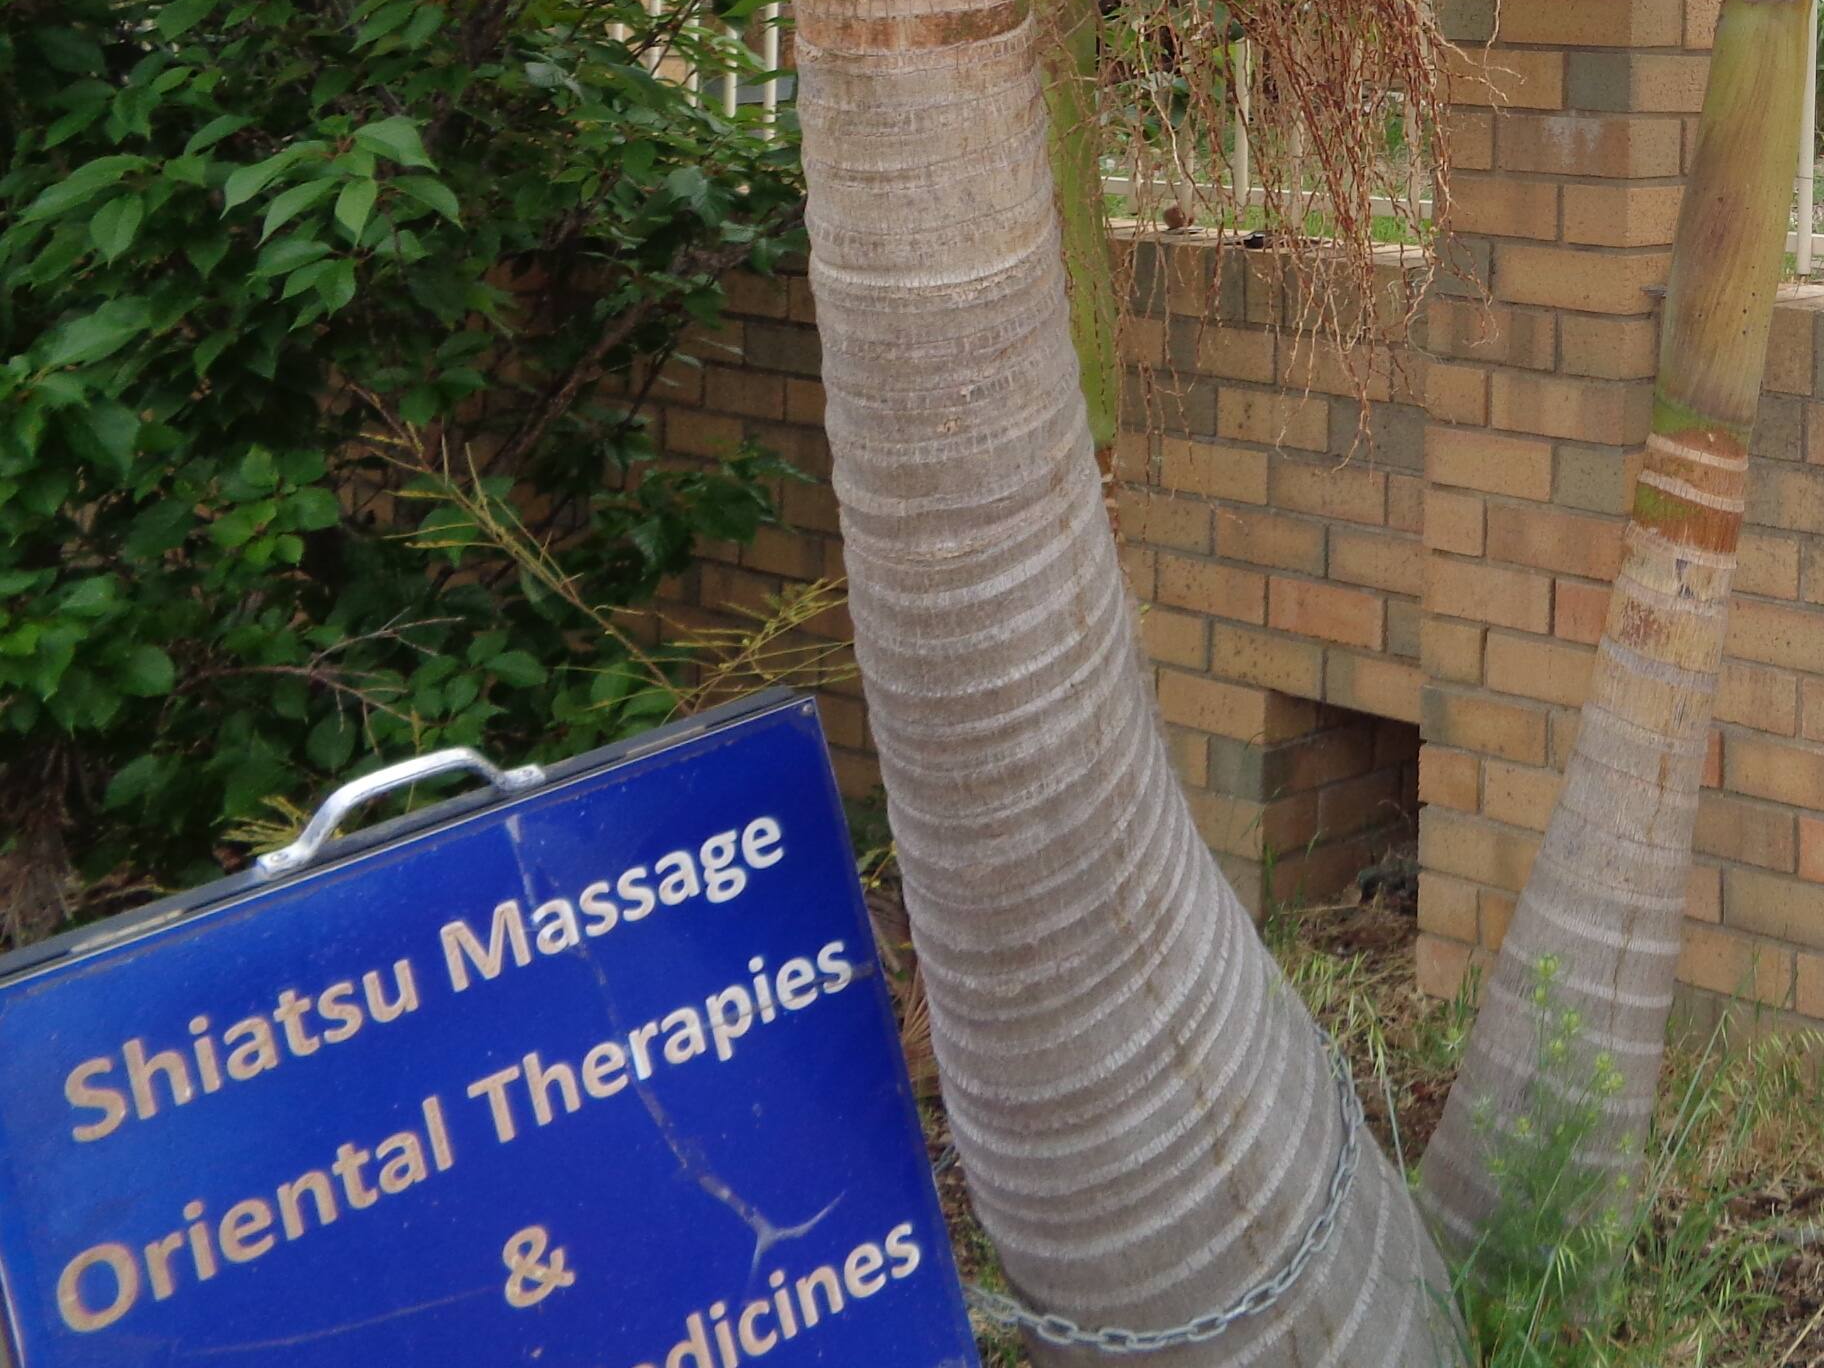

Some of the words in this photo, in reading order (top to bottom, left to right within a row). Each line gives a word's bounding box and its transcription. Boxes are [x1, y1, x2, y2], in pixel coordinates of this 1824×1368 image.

[64, 958, 421, 1143] Shiatsu
[440, 816, 785, 994] Massage
[56, 1095, 454, 1334] Oriental
[468, 938, 854, 1144] Therapies
[502, 1225, 576, 1308] &
[632, 1222, 921, 1368] dicines
